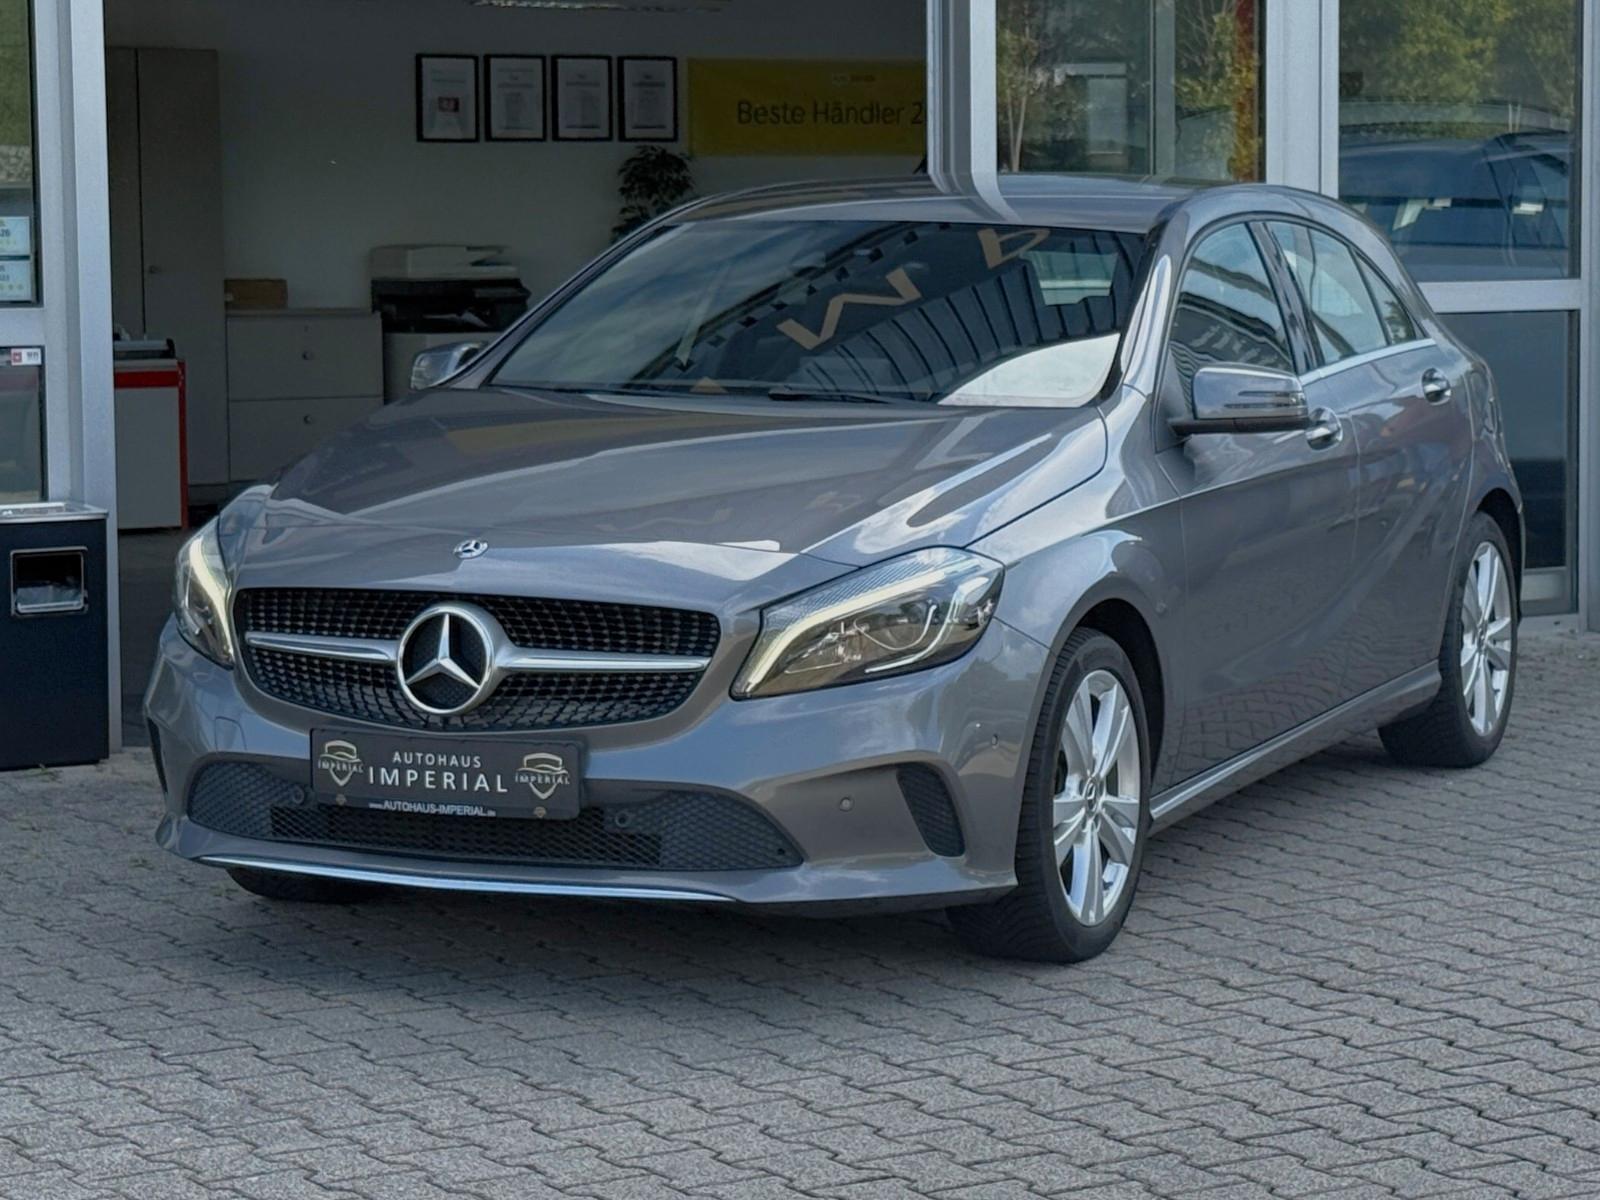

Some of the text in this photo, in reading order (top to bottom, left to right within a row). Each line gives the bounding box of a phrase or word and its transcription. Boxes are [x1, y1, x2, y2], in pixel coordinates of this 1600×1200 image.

[736, 99, 806, 125] Beste
[813, 100, 904, 125] Händler
[317, 759, 364, 774] IMPERIAL
[392, 751, 482, 768] AUTOHAUS
[368, 765, 509, 793] IMPERIAL
[514, 772, 571, 785] IMPERIAL
[368, 799, 497, 818] AUTOHAUS-IMPERIAL.
